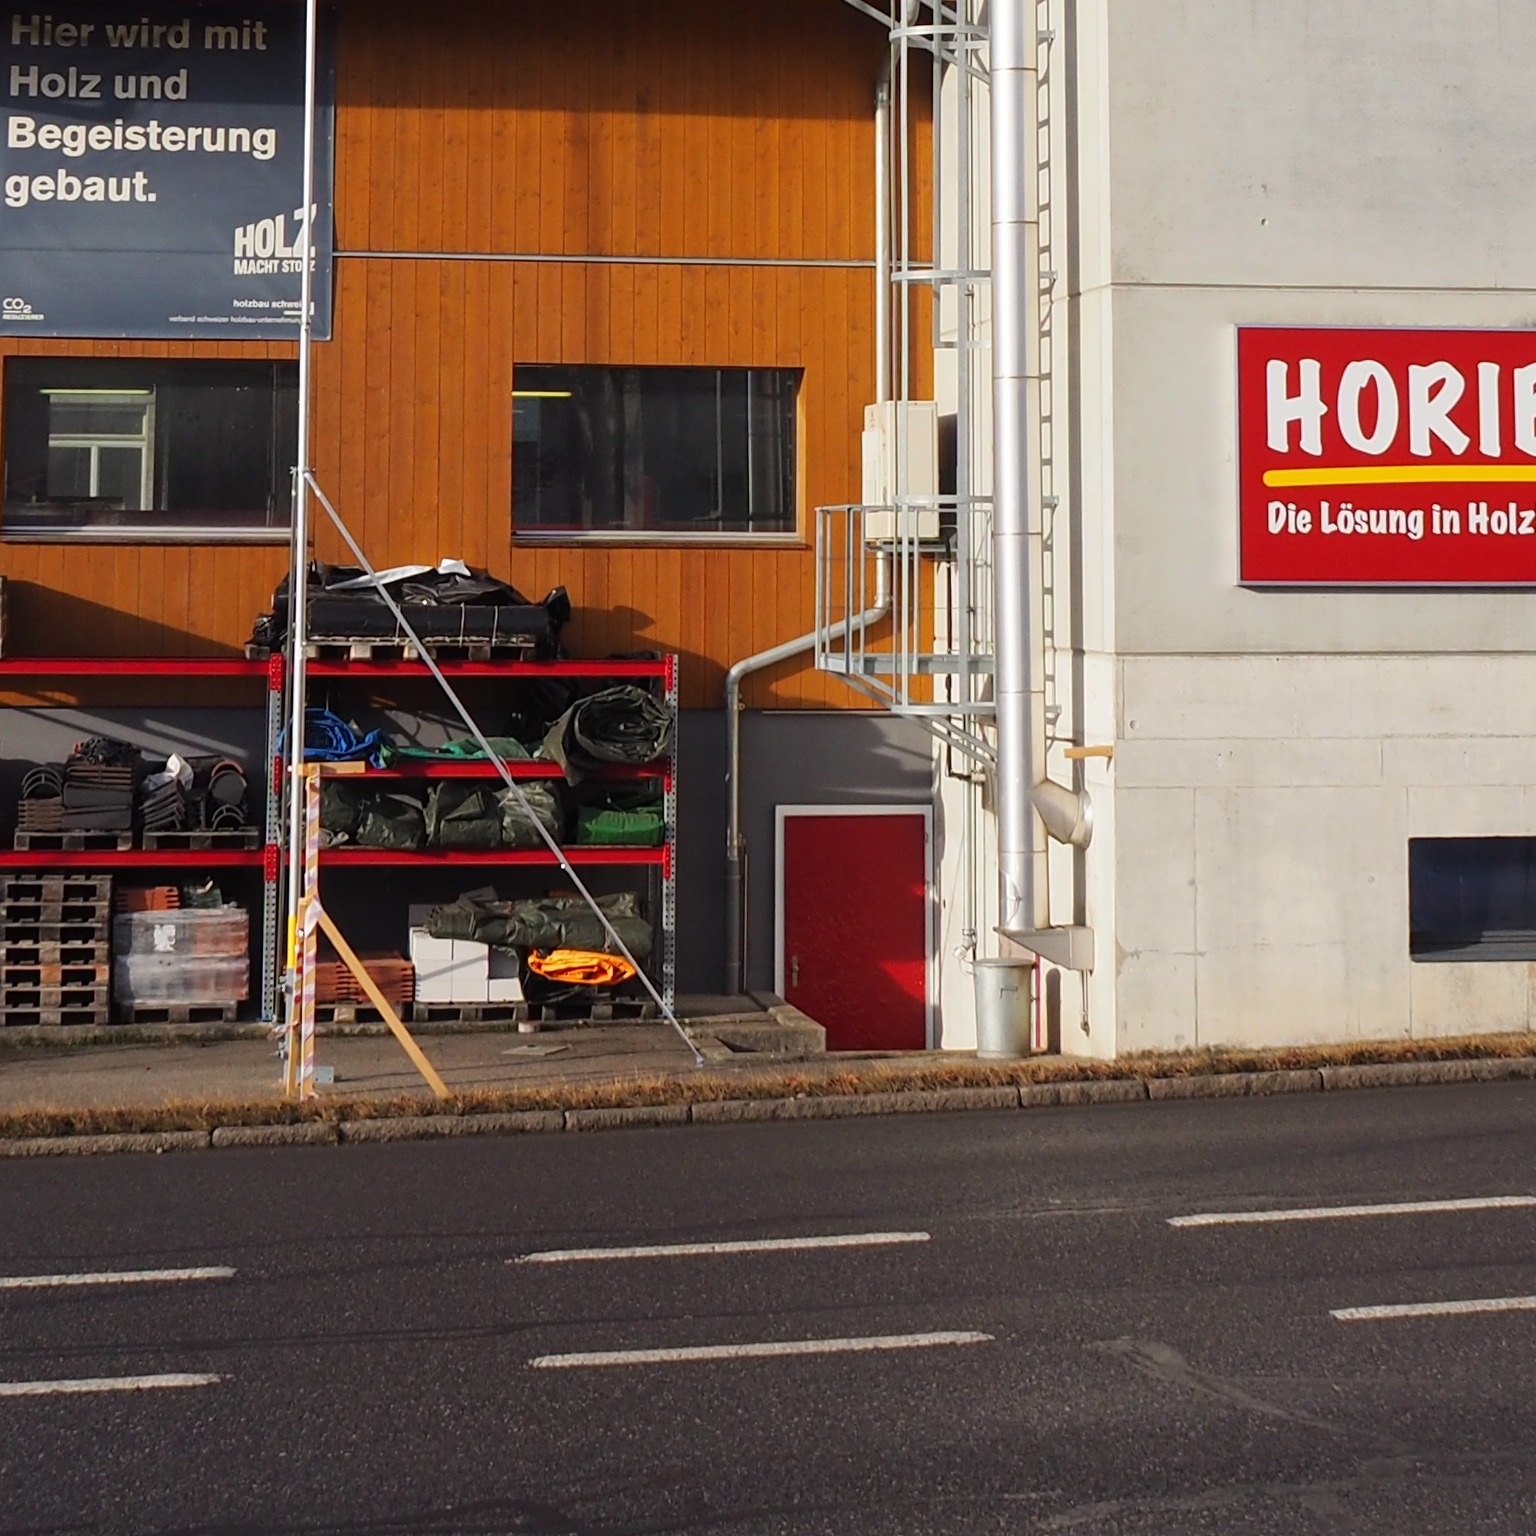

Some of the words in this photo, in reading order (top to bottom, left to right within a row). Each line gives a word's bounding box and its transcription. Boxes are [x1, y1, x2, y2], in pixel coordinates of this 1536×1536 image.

[11, 15, 95, 47] Hier
[105, 17, 190, 49] wird
[204, 19, 268, 51] mit
[9, 65, 102, 98] Holz
[114, 68, 188, 100] und
[7, 116, 277, 161] Begeisterung
[4, 168, 157, 208] gebaut.
[234, 203, 318, 258] HOLZ
[233, 258, 280, 275] MACHT
[281, 259, 316, 273] STOZ
[232, 298, 270, 309] holzbau
[1267, 500, 1313, 534] Die
[1320, 500, 1424, 540] Lösung
[1431, 503, 1461, 535] in
